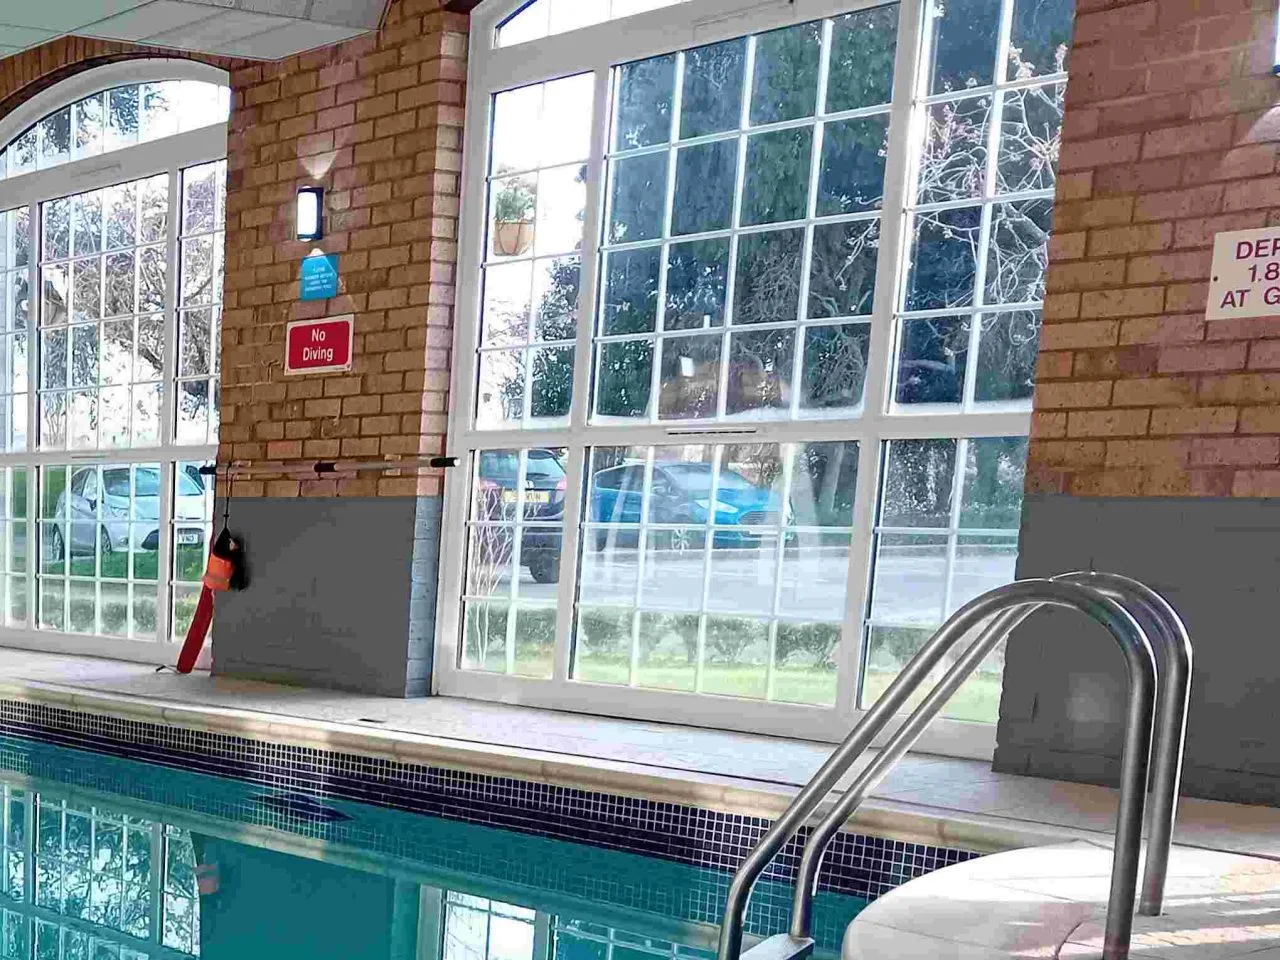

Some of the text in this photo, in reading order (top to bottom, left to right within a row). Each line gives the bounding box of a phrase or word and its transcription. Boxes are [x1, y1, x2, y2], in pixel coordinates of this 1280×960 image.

[1220, 289, 1251, 309] AT
[311, 328, 326, 342] No
[302, 346, 334, 362] Diving
